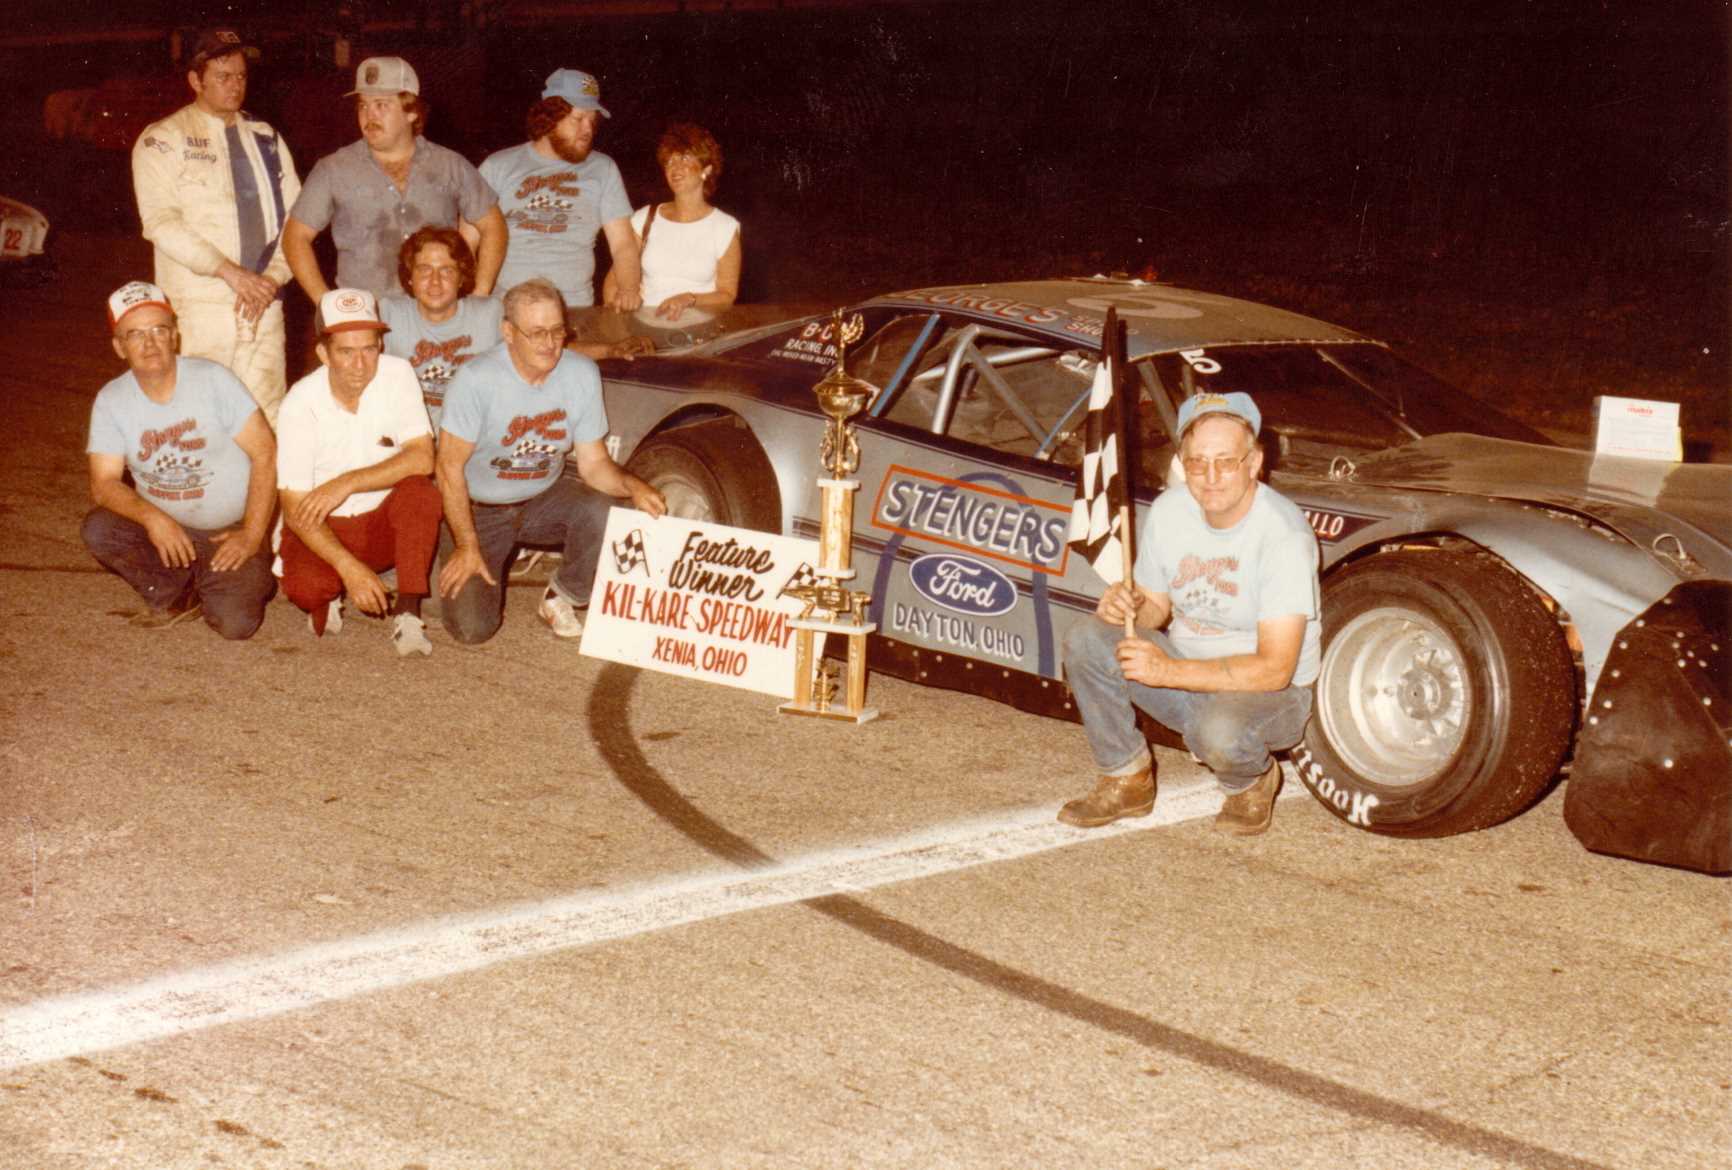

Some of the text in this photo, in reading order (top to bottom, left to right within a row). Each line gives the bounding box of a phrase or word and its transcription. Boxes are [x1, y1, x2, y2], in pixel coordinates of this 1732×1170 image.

[784, 338, 823, 354] RACING
[882, 479, 1067, 563] STENGERS
[678, 531, 775, 575] Feature
[668, 560, 764, 602] Winner
[929, 560, 998, 609] Ford
[601, 581, 797, 650] KIL-KARE SPEEDWAY
[652, 636, 748, 677] XENIA, OHIO
[980, 625, 1025, 662] OHIO
